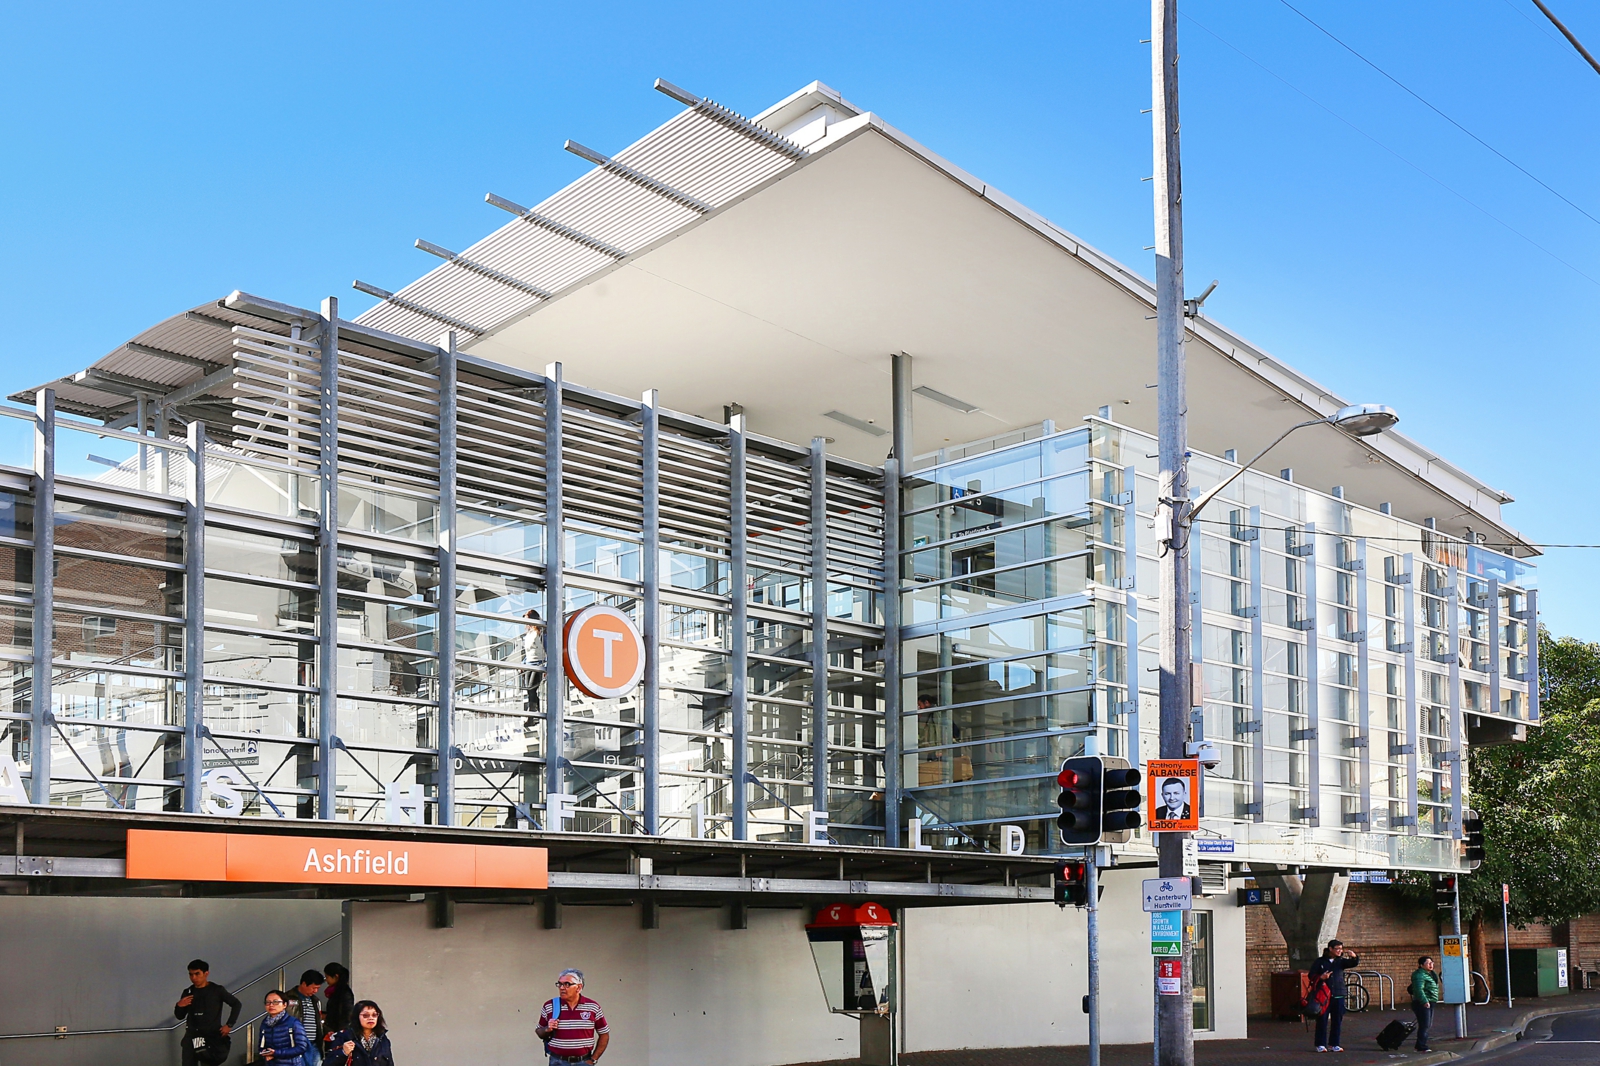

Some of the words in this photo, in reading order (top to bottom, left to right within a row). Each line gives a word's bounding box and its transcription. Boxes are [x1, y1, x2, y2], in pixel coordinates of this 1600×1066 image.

[592, 628, 623, 678] T
[1149, 769, 1197, 777] ALBANESE
[1149, 820, 1177, 829] Labor
[303, 848, 409, 875] Ashfield
